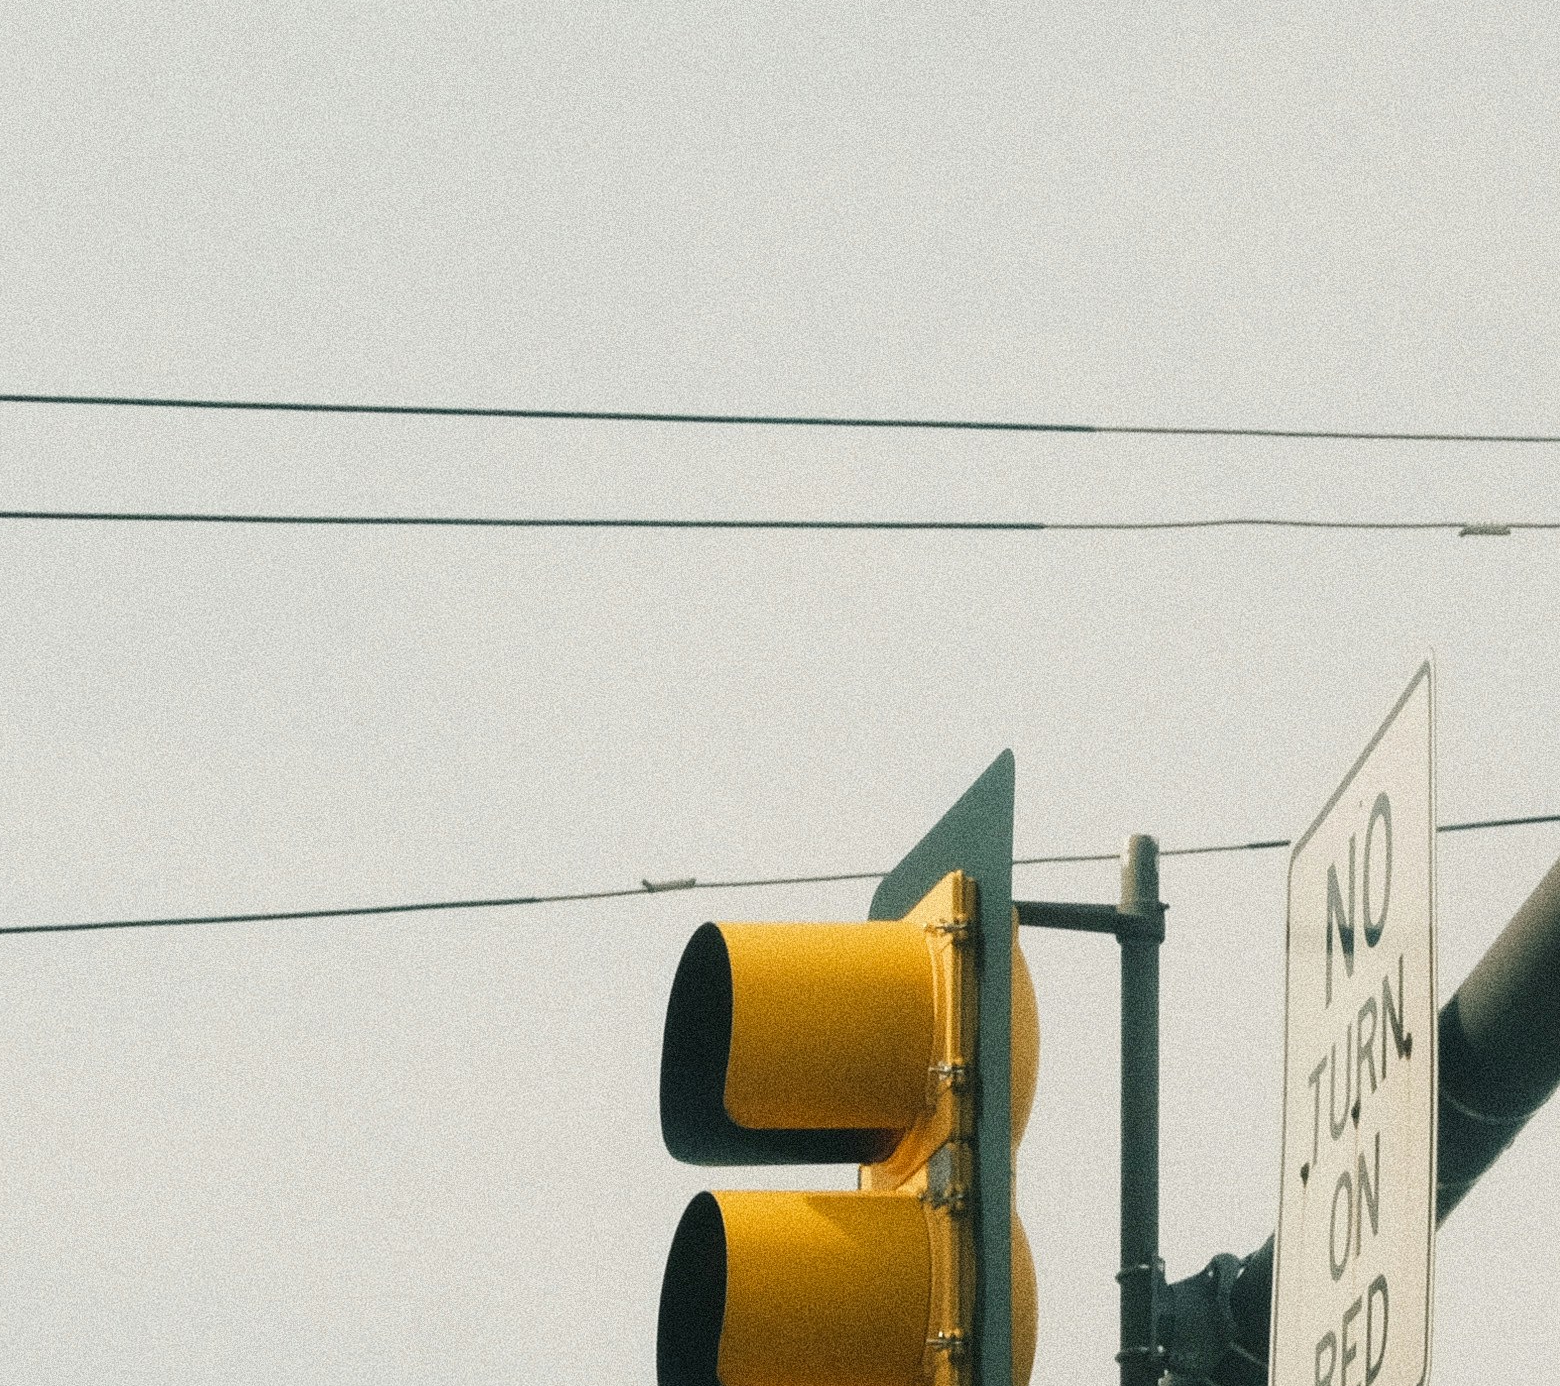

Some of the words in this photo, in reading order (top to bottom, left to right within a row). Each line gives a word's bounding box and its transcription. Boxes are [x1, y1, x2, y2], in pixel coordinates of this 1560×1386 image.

[1325, 791, 1393, 1009] NO
[1306, 955, 1409, 1166] TURN
[1329, 1131, 1382, 1284] ON
